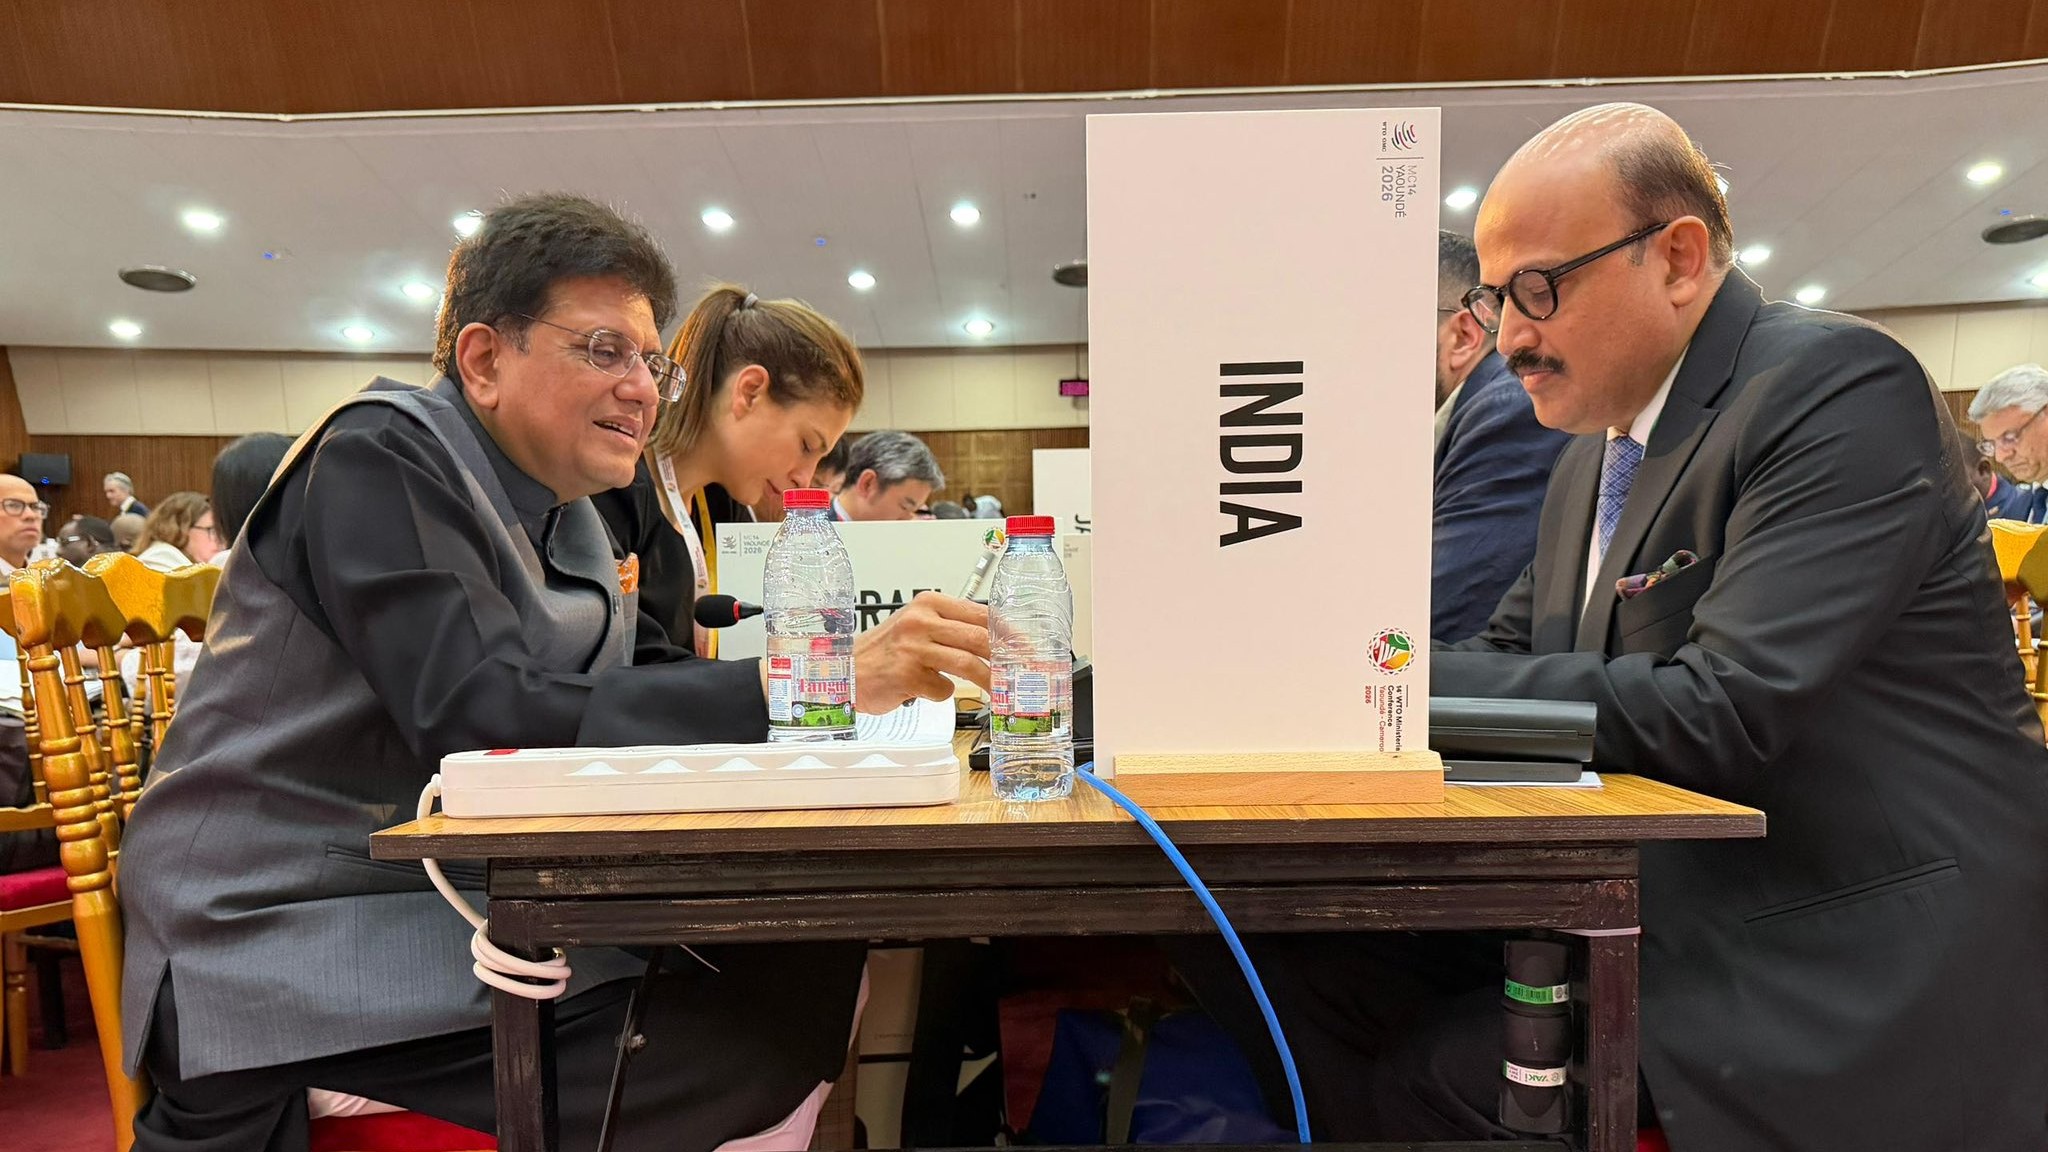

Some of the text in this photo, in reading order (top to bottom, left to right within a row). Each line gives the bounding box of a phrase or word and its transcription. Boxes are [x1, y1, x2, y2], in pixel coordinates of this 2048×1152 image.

[1382, 166, 1394, 202] 2026
[1395, 164, 1407, 218] YAOUNDÉ
[1407, 164, 1417, 196] MC14
[1220, 361, 1303, 547] INDIA
